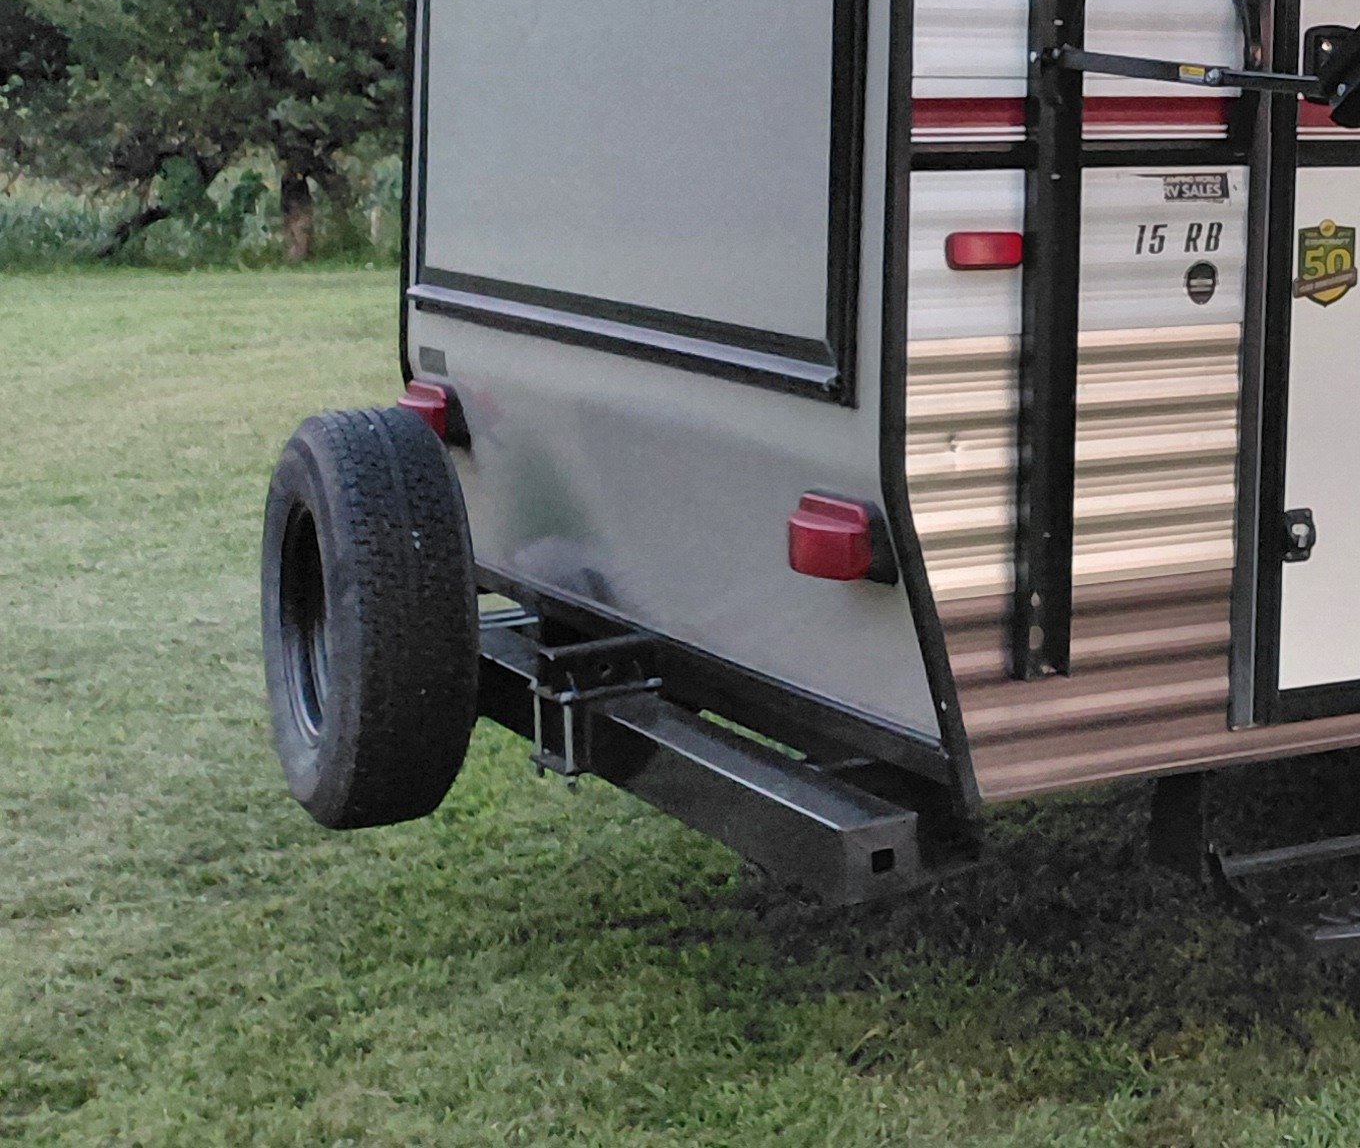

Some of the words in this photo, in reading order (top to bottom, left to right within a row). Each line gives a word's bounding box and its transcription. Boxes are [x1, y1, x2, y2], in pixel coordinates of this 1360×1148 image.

[1181, 184, 1222, 197] SALES
[1135, 223, 1169, 255] 15
[1183, 221, 1223, 253] RB
[1301, 246, 1352, 281] 50
